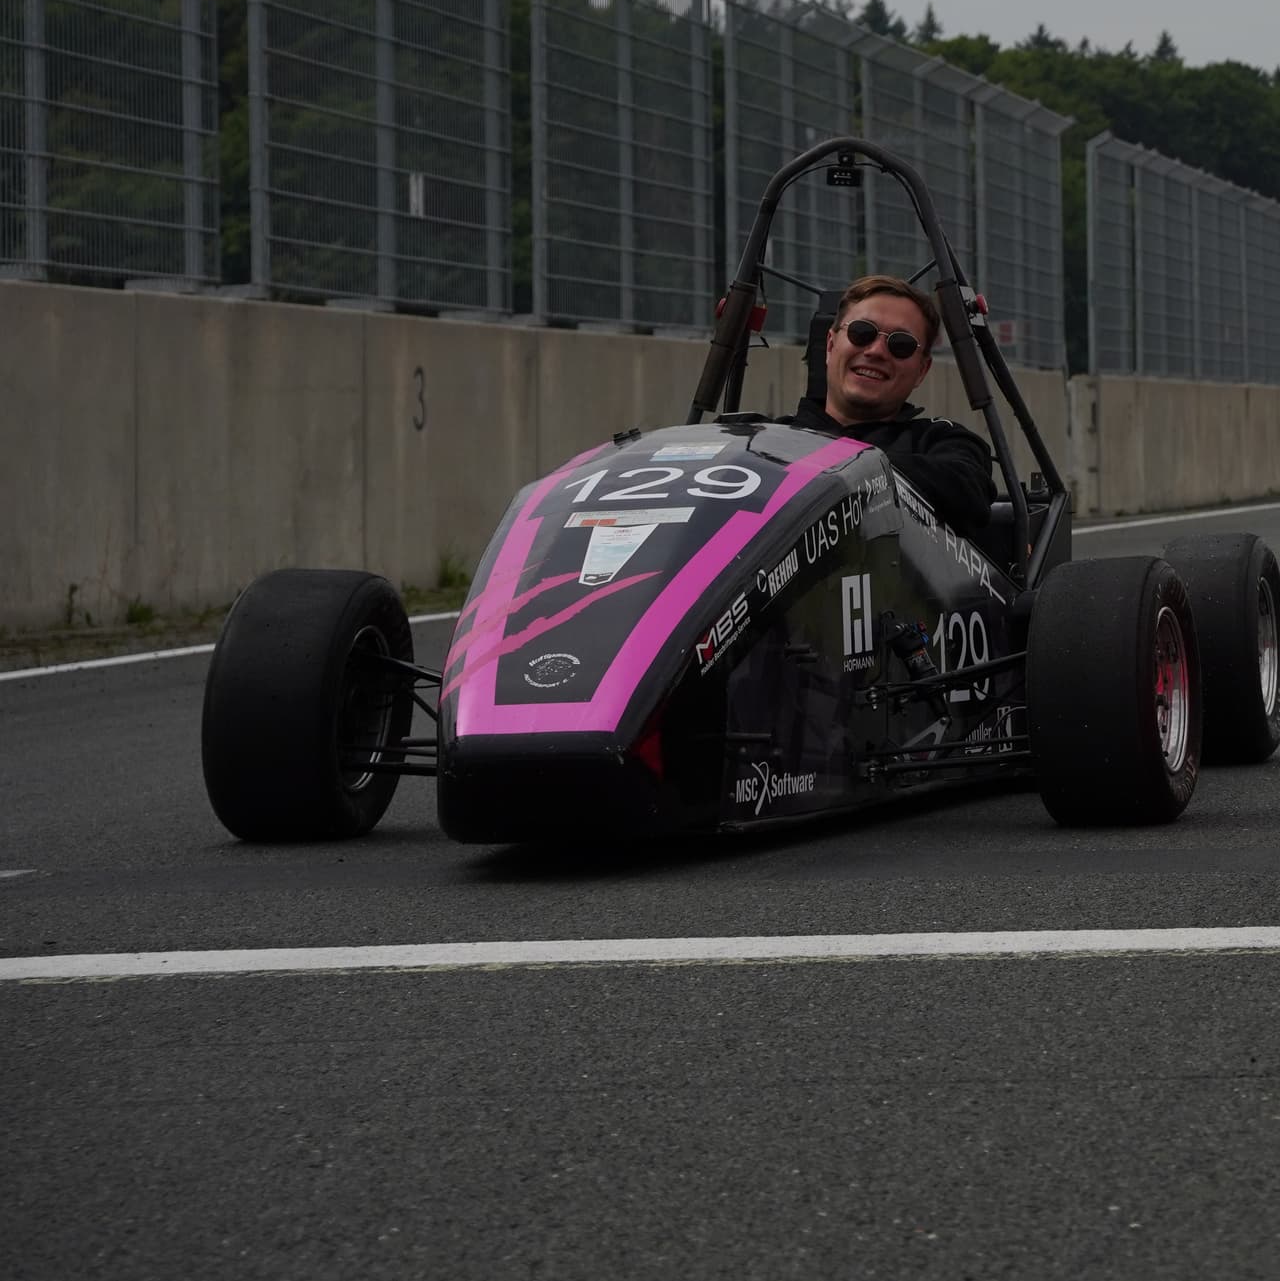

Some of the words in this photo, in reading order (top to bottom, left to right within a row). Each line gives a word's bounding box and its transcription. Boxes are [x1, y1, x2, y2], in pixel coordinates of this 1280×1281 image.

[564, 464, 762, 504] 129
[804, 510, 839, 565] UAS
[841, 485, 864, 536] Hof
[767, 547, 799, 598] REHAU
[944, 521, 1007, 606] RAPA
[696, 591, 749, 665] MBS
[843, 655, 875, 672] HOFMANN
[736, 776, 758, 804] MSC
